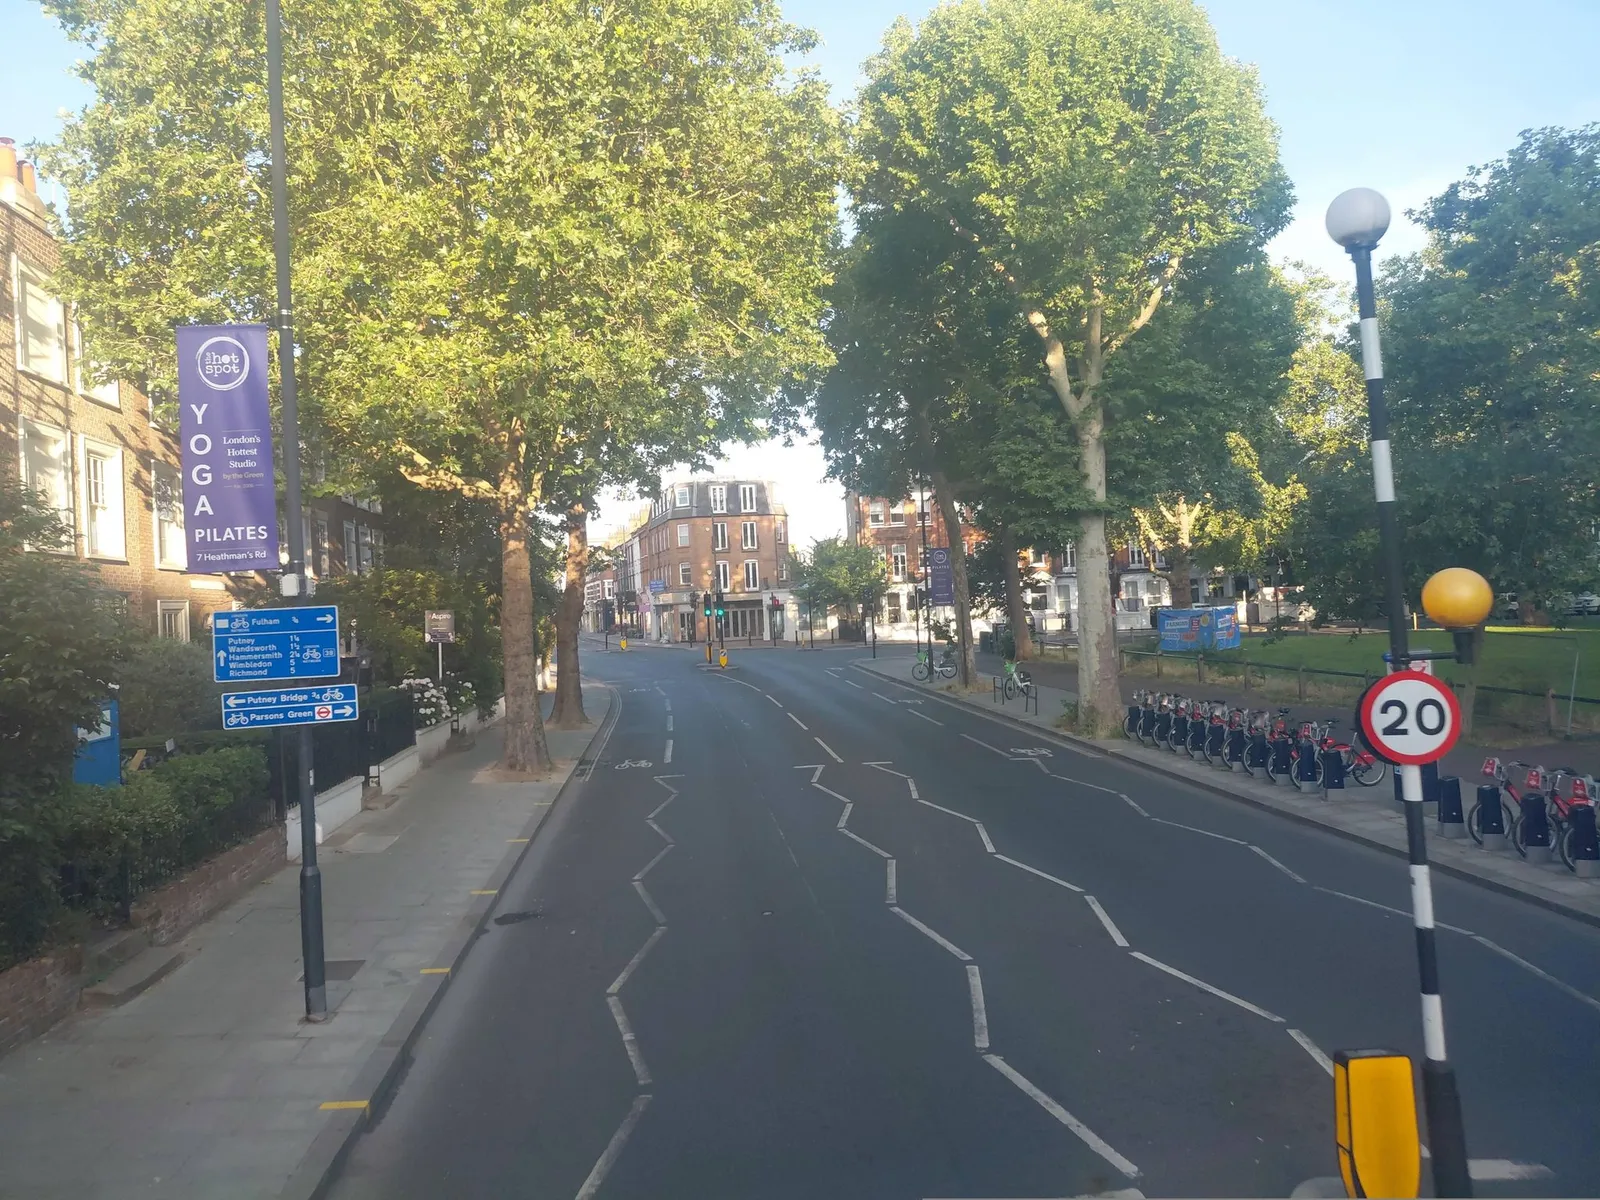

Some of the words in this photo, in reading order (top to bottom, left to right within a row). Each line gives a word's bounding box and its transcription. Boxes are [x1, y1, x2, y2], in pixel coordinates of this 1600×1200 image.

[211, 351, 240, 365] hot
[205, 364, 240, 377] spot
[222, 435, 261, 445] London's
[227, 448, 258, 457] Hottest
[189, 403, 214, 516] YOGA
[229, 459, 257, 469] Studio
[244, 471, 264, 479] Green
[194, 525, 268, 543] PILATES
[196, 553, 203, 562] 7
[204, 550, 253, 562] Heathman's
[254, 549, 267, 559] Rd
[251, 618, 280, 626] Fulham
[228, 637, 255, 646] Putney
[228, 644, 277, 653] Wandsworth
[229, 652, 283, 661] Hammersmith
[229, 660, 272, 669] Wimbledon
[229, 668, 268, 677] Richmond
[247, 695, 277, 704] Putney
[280, 692, 308, 703] Bridge
[250, 711, 284, 722] Parsons
[287, 709, 313, 719] Green
[1380, 697, 1446, 737] 20
